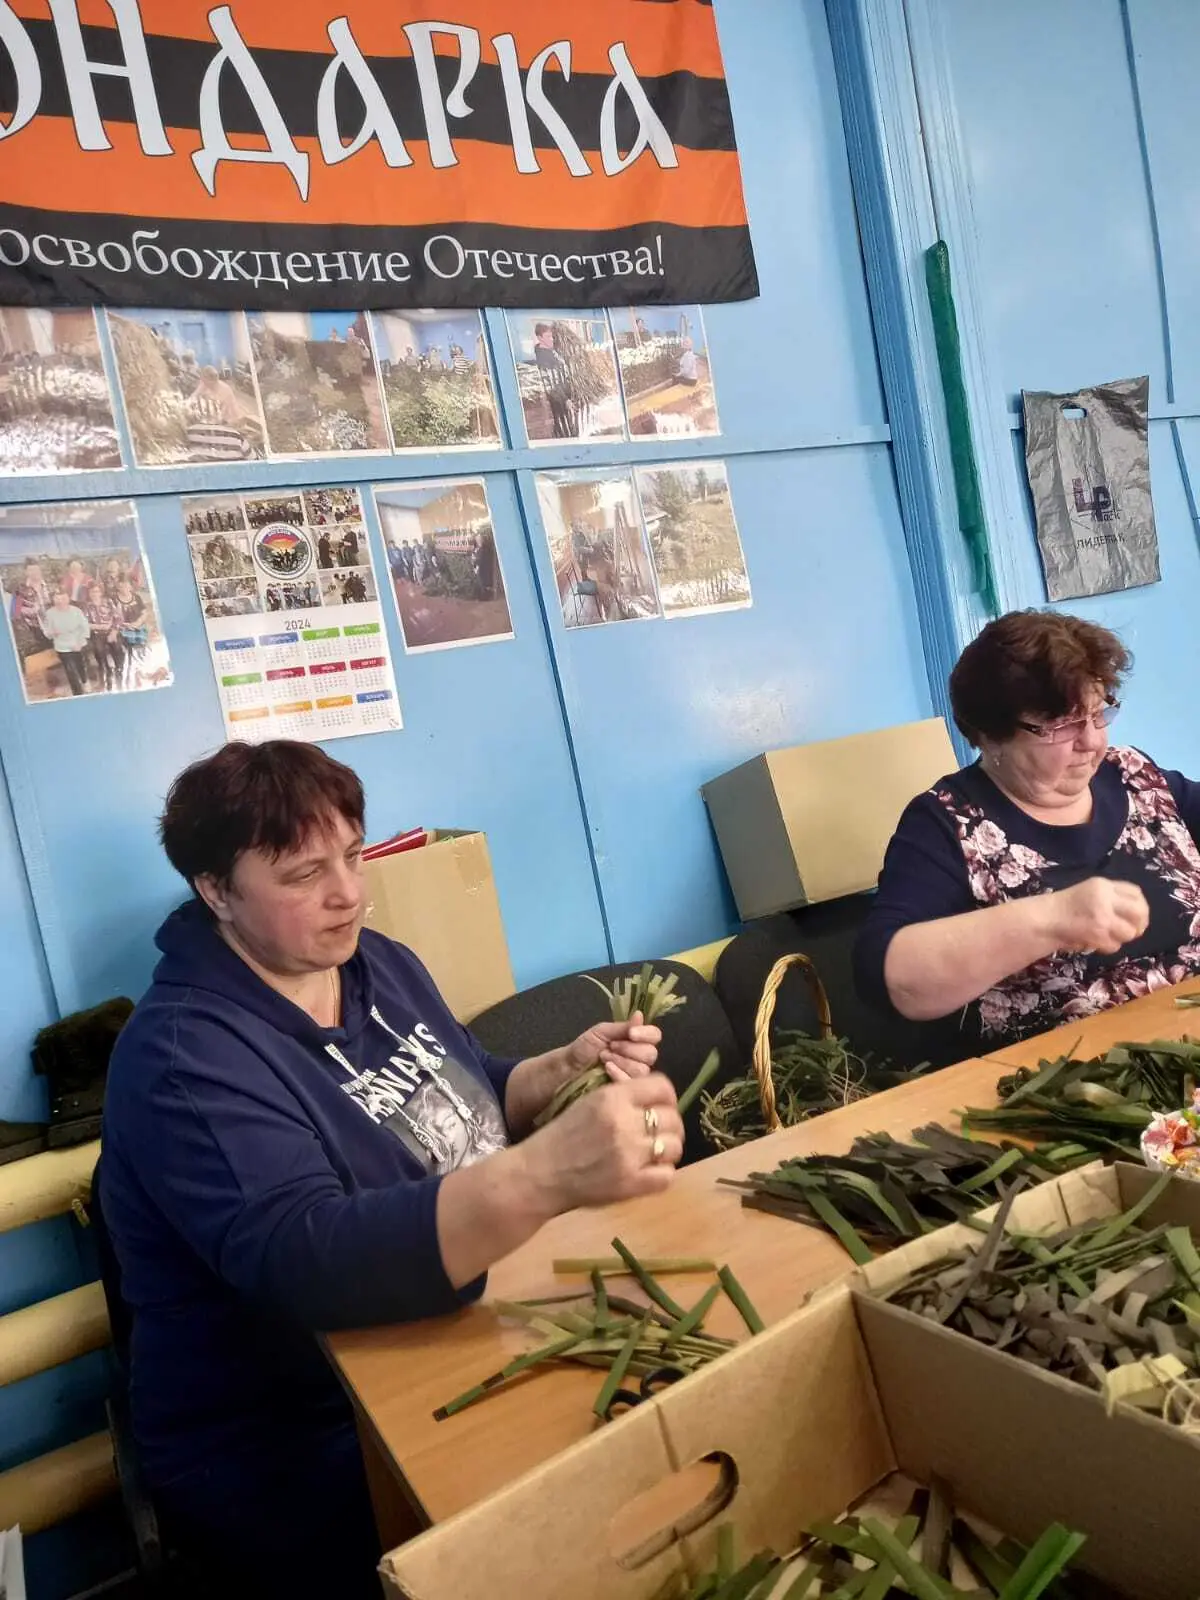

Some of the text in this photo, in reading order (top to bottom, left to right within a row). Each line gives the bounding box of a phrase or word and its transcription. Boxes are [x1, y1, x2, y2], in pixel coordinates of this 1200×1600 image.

[0, 229, 666, 290] освобождение Отечества!
[284, 619, 312, 631] 2024
